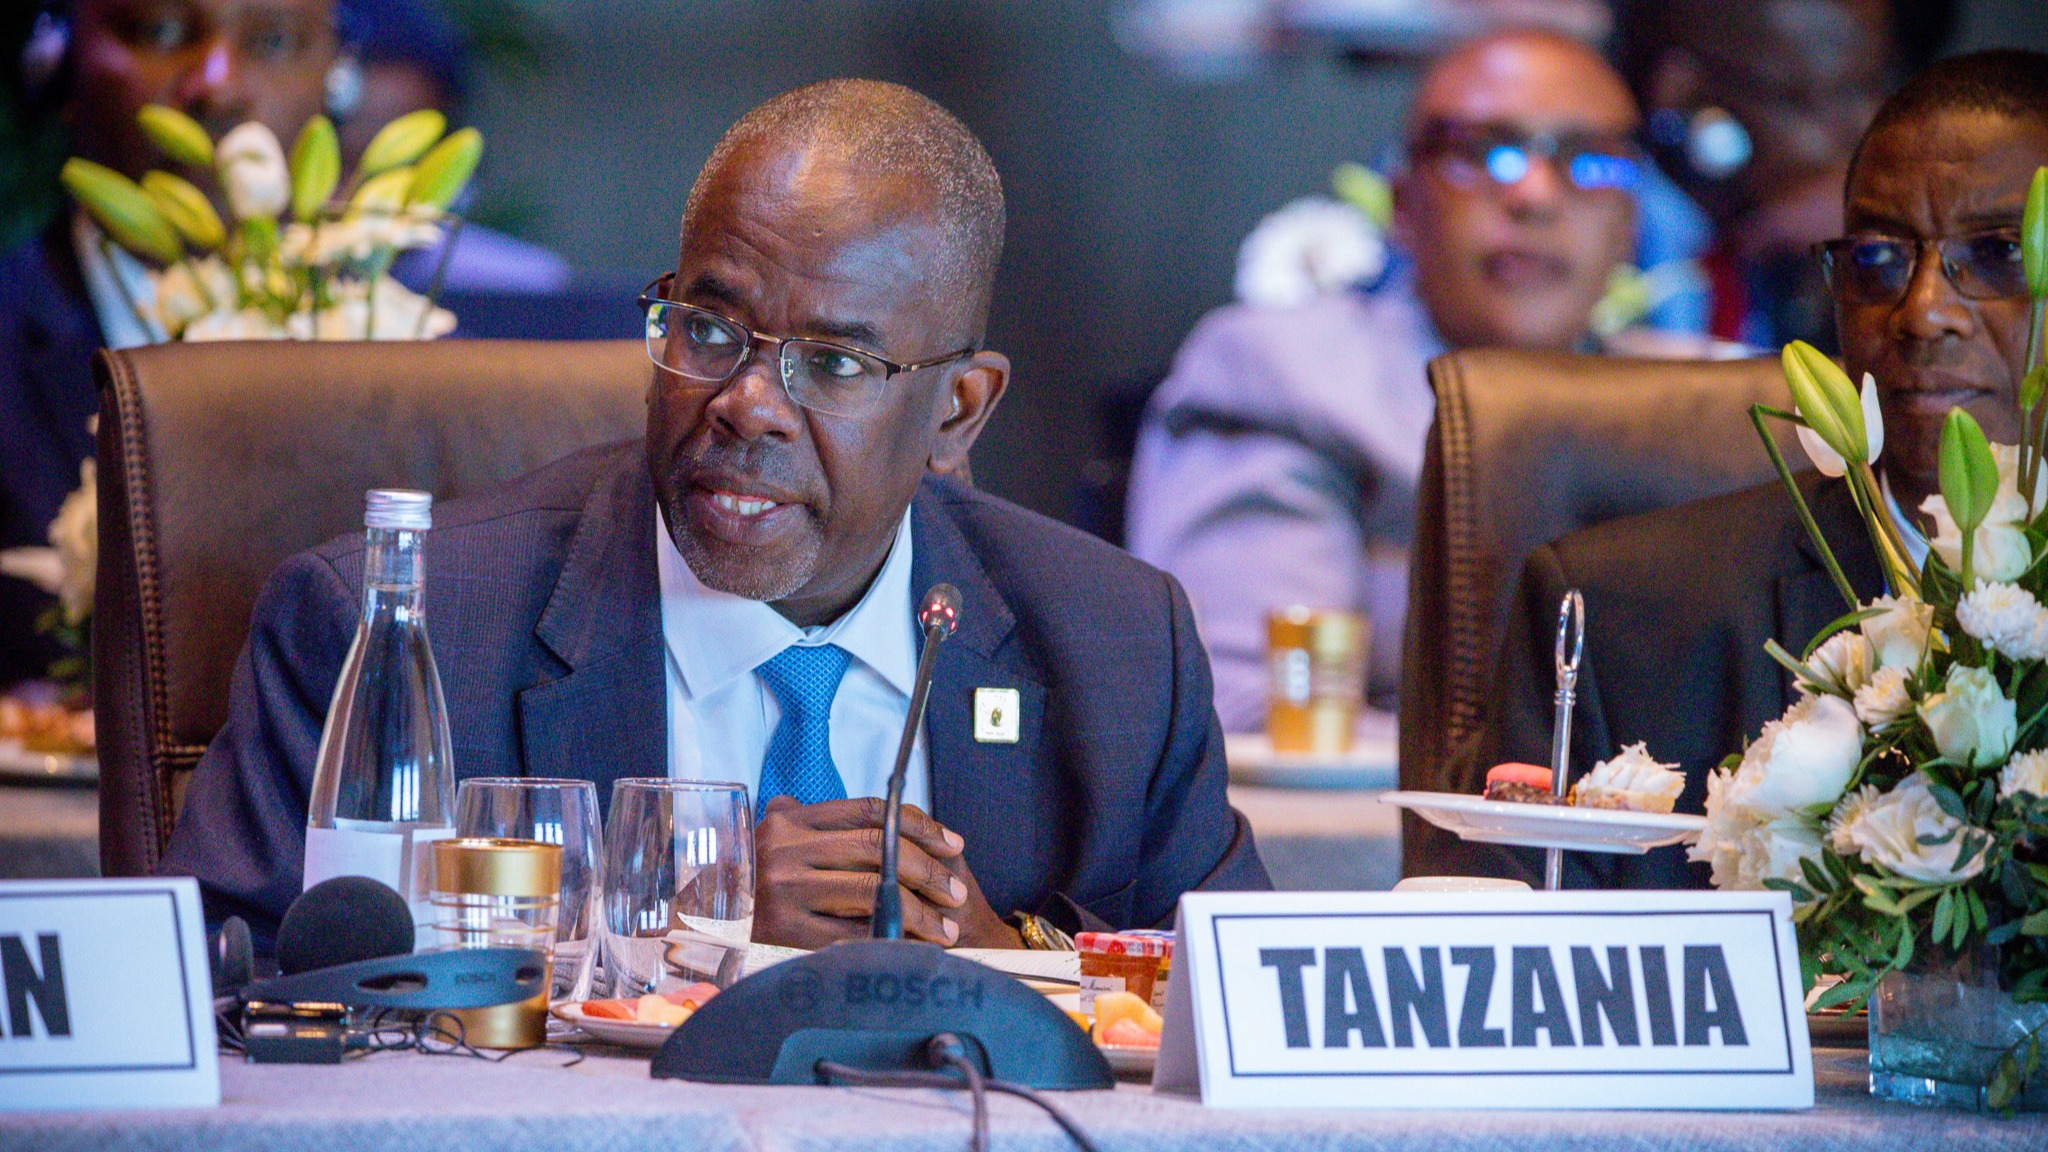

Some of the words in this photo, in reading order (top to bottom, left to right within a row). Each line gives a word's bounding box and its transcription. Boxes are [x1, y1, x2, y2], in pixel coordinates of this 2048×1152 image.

[0, 934, 72, 1037] N
[846, 972, 985, 1009] BOSCH
[1258, 944, 1750, 1049] TANZANIA
